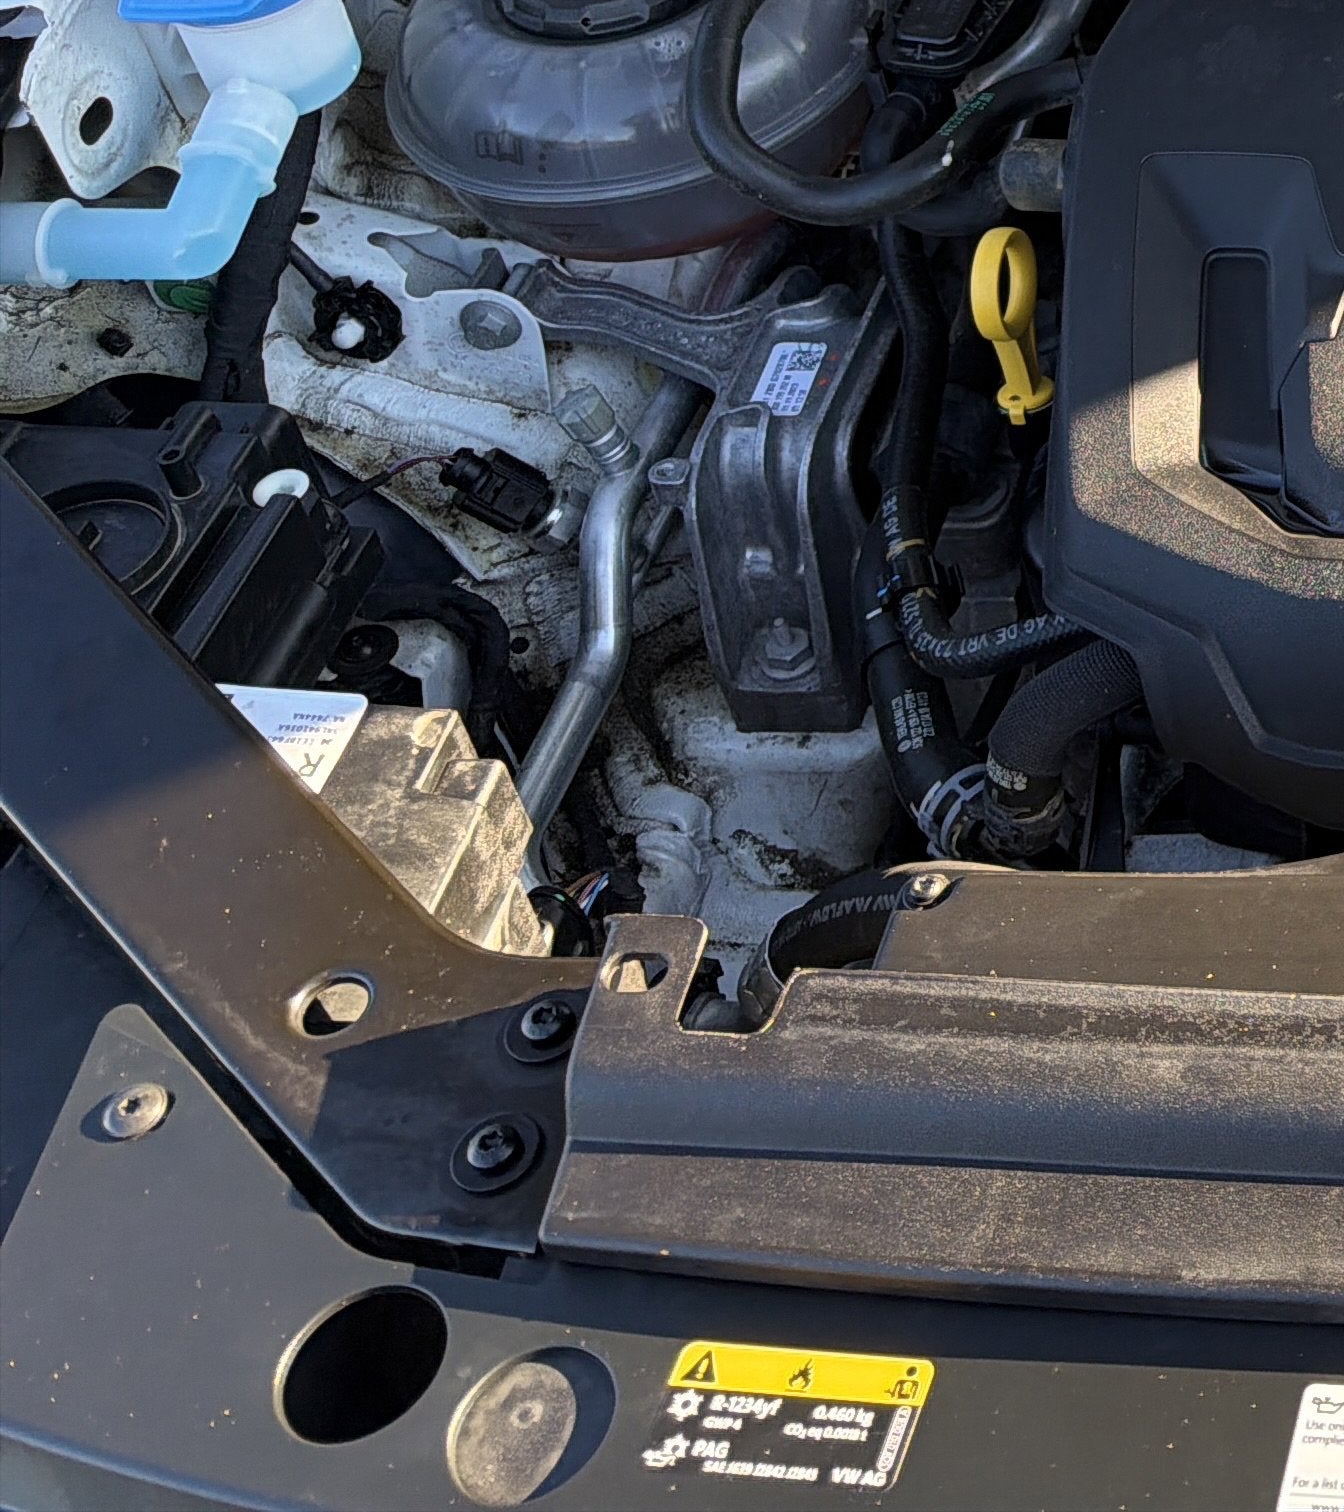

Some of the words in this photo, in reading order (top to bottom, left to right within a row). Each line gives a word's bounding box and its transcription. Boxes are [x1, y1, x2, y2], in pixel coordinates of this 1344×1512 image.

[299, 752, 326, 778] R
[709, 1393, 783, 1420] R-1234yf
[1305, 1419, 1324, 1431] Use
[690, 1439, 731, 1459] PAG
[831, 1466, 863, 1484] VW
[859, 1469, 887, 1487] AG
[1292, 1476, 1310, 1488] For
[1322, 1478, 1338, 1489] list
